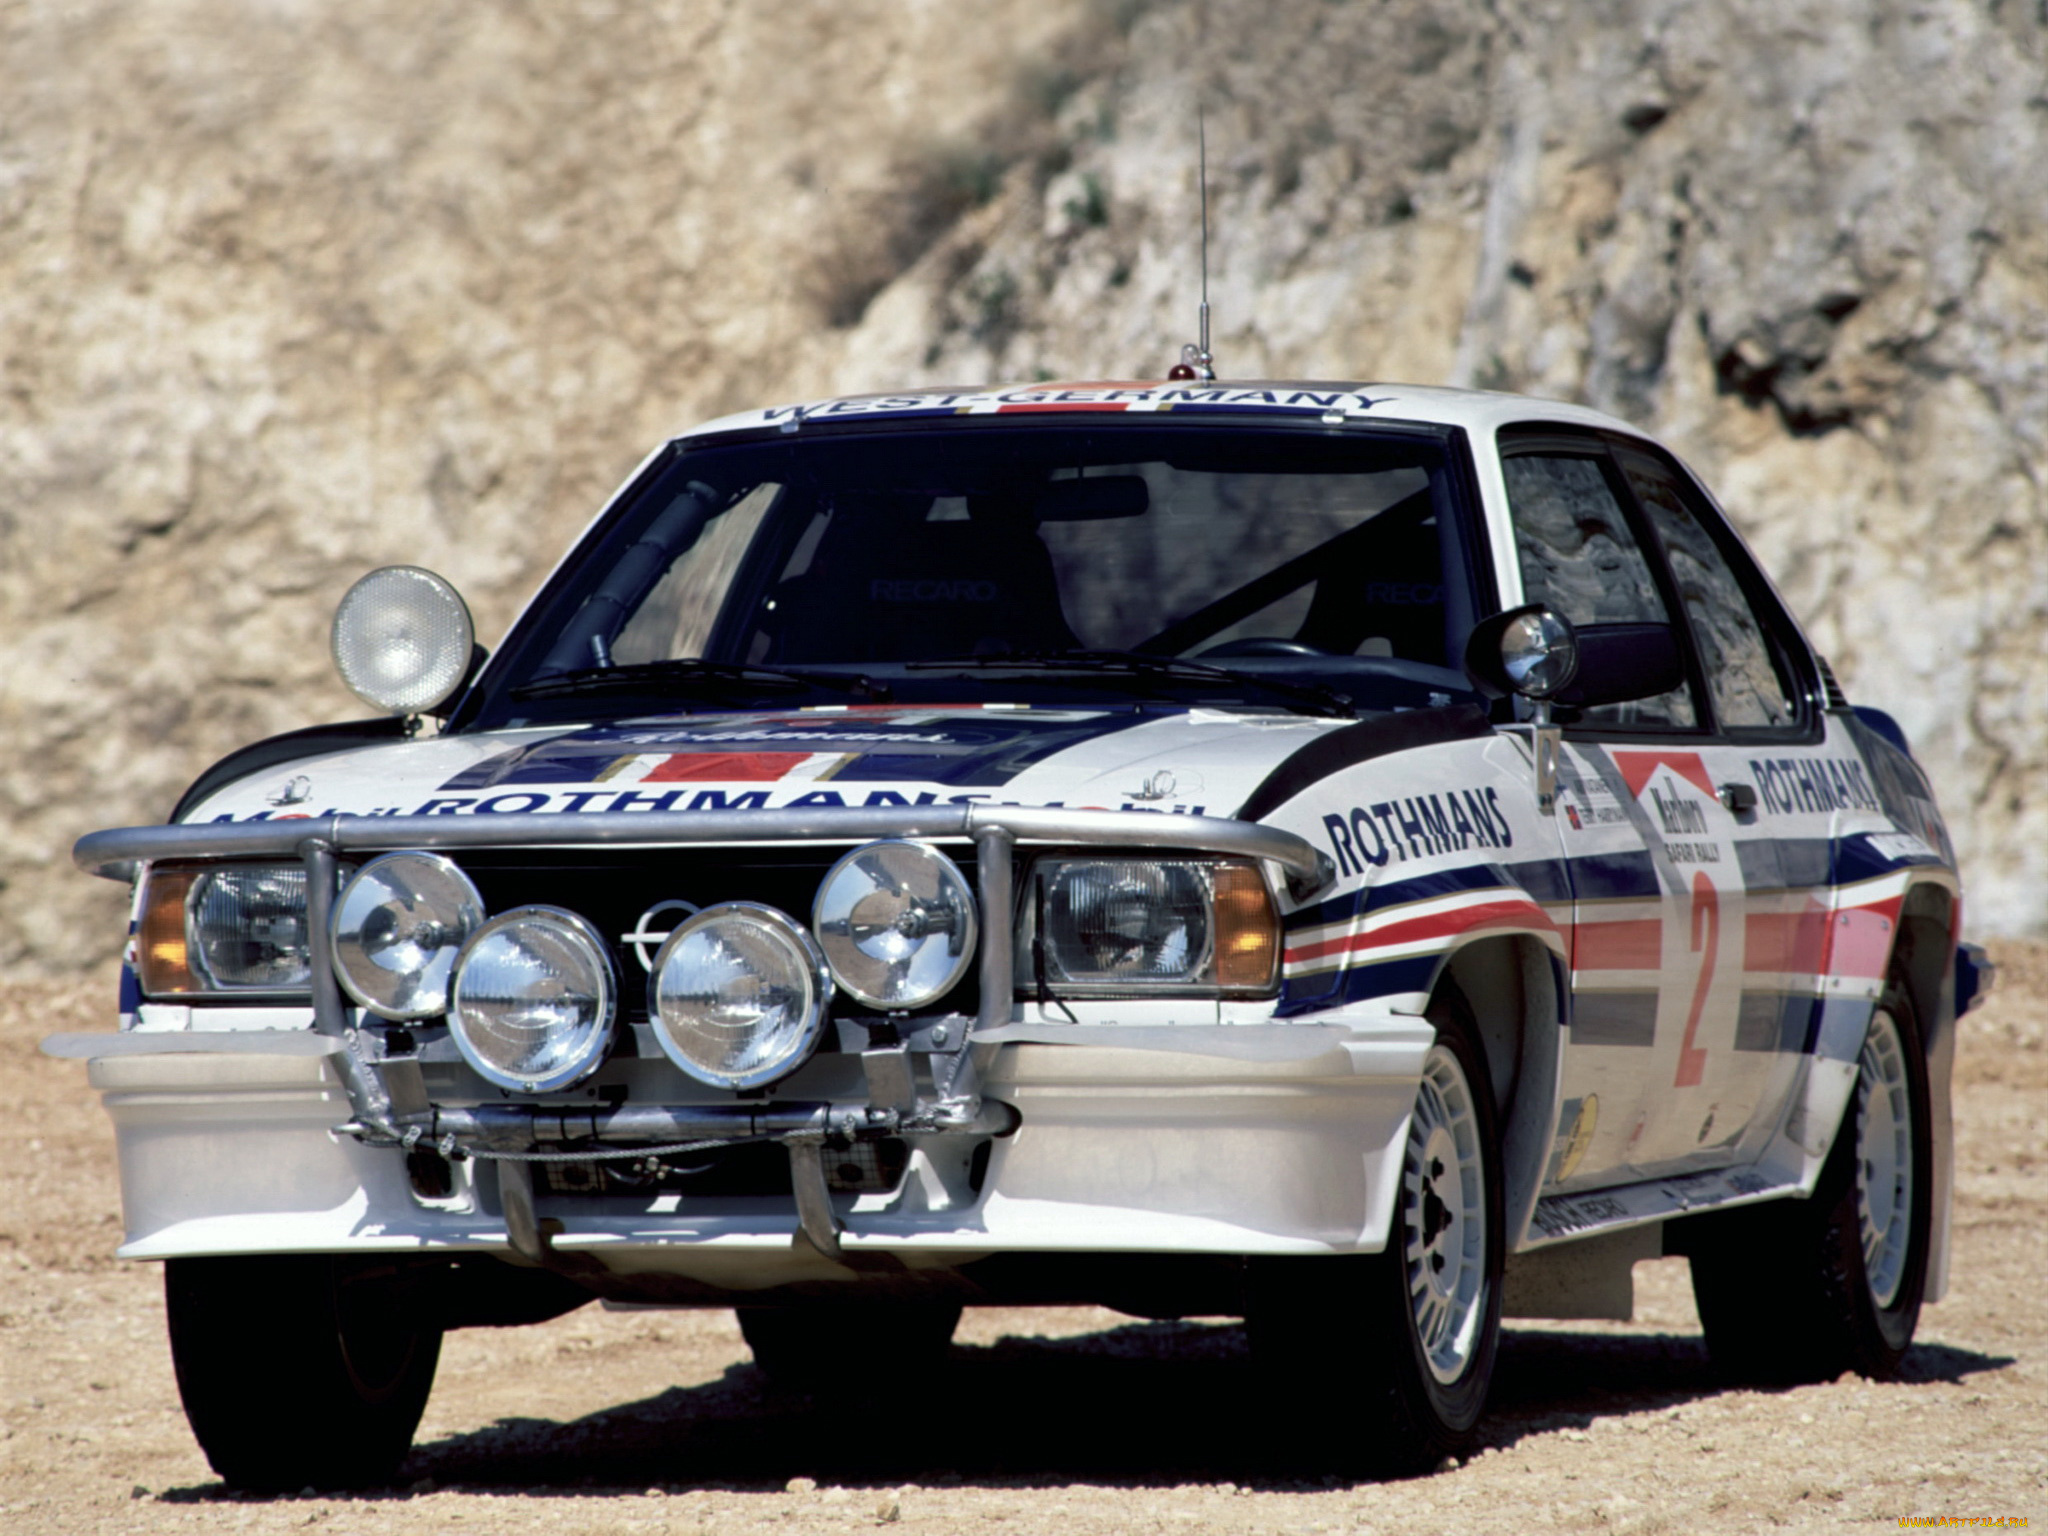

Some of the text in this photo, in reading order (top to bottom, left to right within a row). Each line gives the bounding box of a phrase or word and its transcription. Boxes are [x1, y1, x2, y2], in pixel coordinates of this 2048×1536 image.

[870, 578, 997, 602] RECARO
[1322, 786, 1512, 878] ROTHMANS
[1673, 870, 1720, 1087] 2
